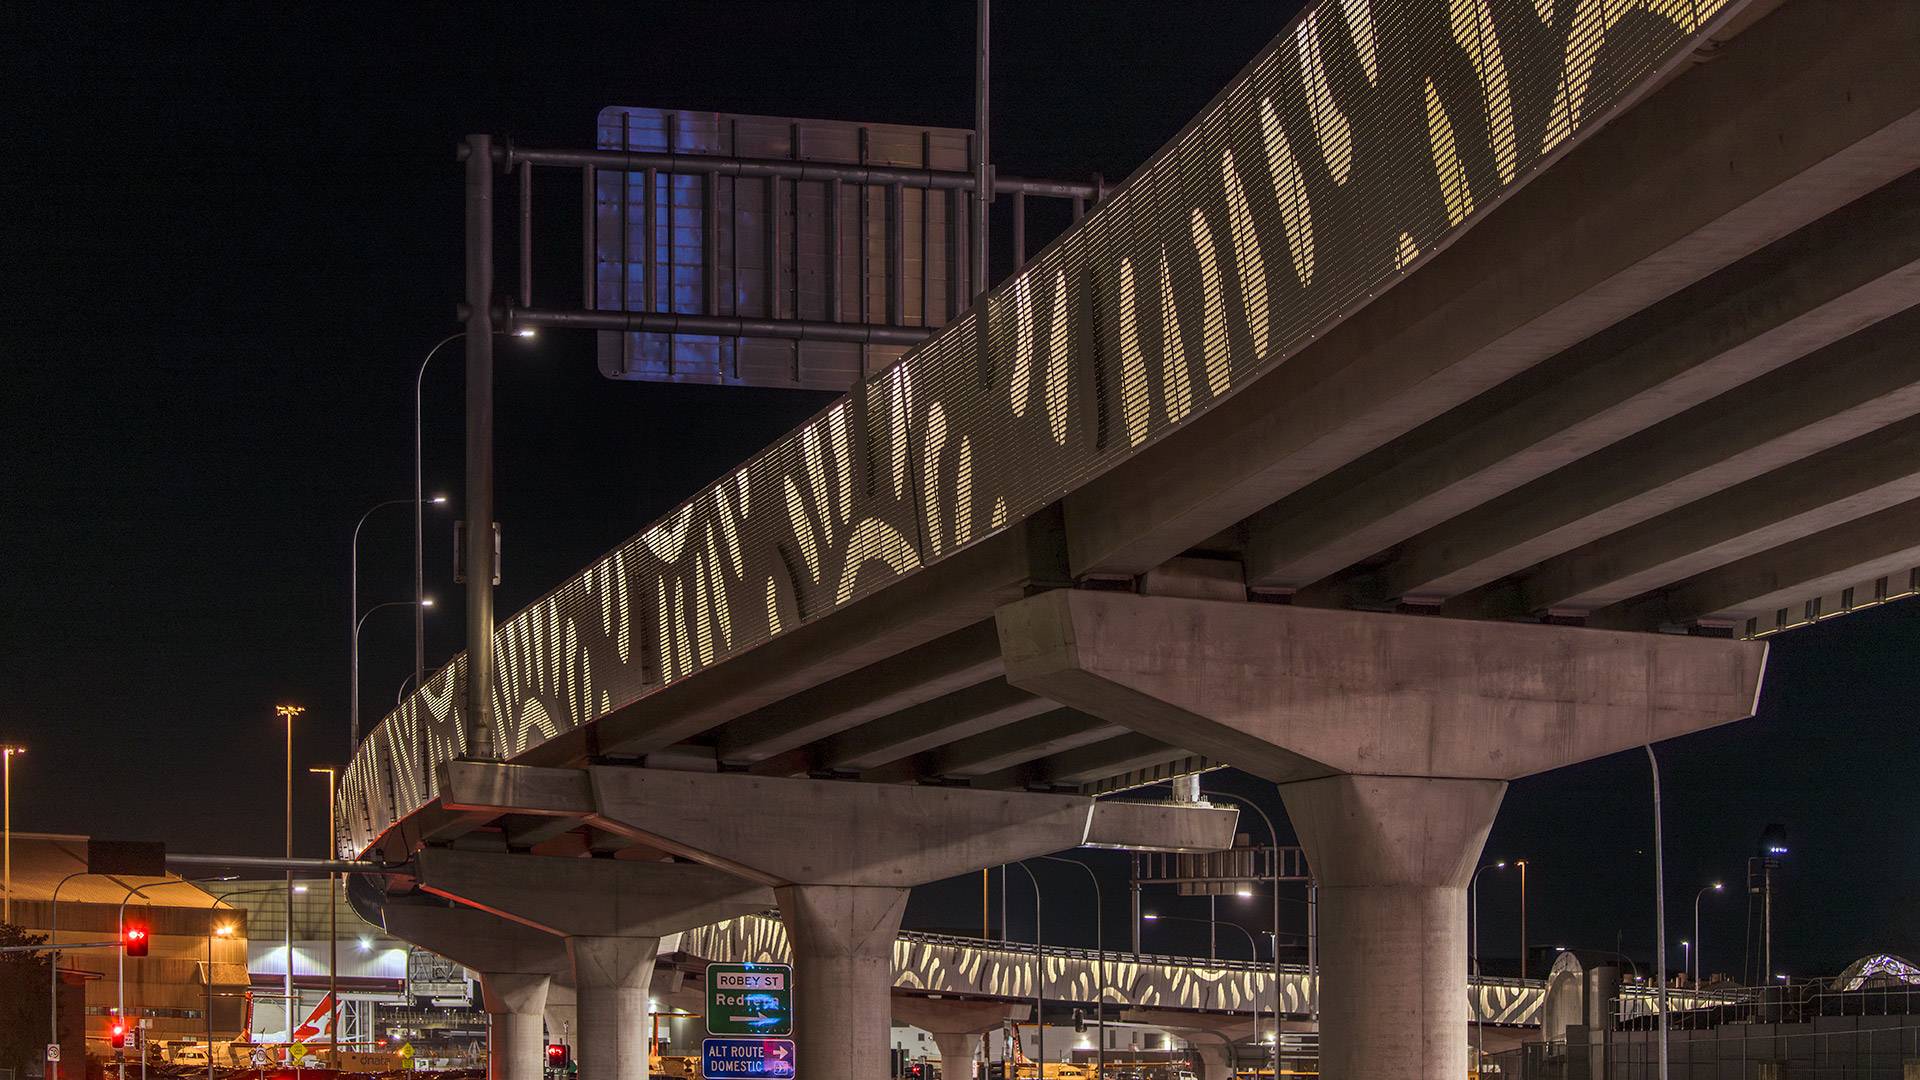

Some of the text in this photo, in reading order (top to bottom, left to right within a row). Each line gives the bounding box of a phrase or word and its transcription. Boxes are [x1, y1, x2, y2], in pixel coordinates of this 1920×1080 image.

[720, 976, 779, 986] ROBEY ST
[709, 1046, 764, 1058] ALT ROUTE
[711, 1061, 762, 1073] DOMESTIC
